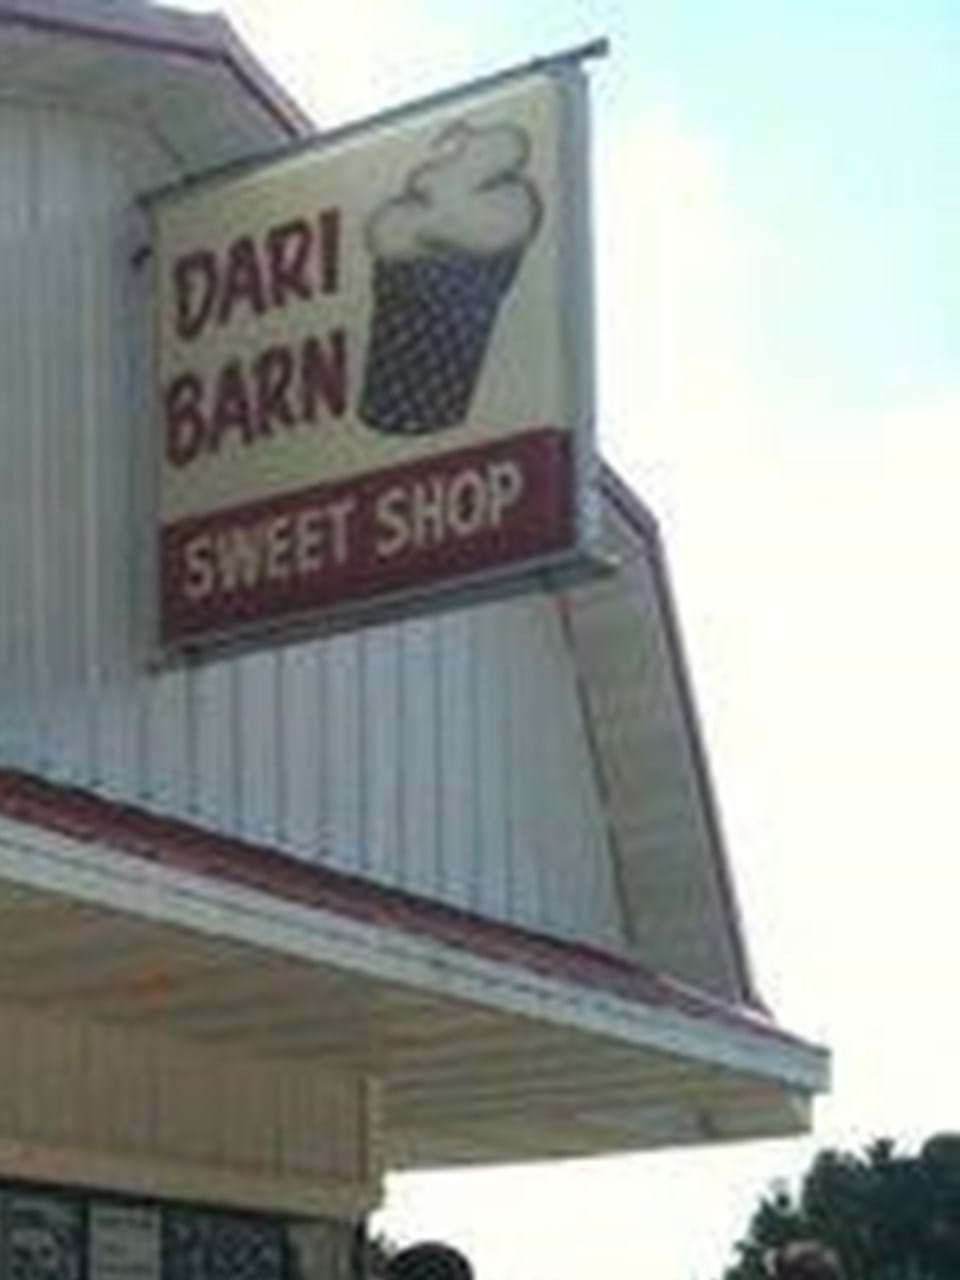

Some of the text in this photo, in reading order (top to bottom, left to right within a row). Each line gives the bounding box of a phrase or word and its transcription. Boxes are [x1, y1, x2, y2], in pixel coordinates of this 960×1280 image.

[172, 208, 341, 341] DARI
[165, 329, 348, 470] BARN
[183, 461, 523, 600] SWEET SHOP
